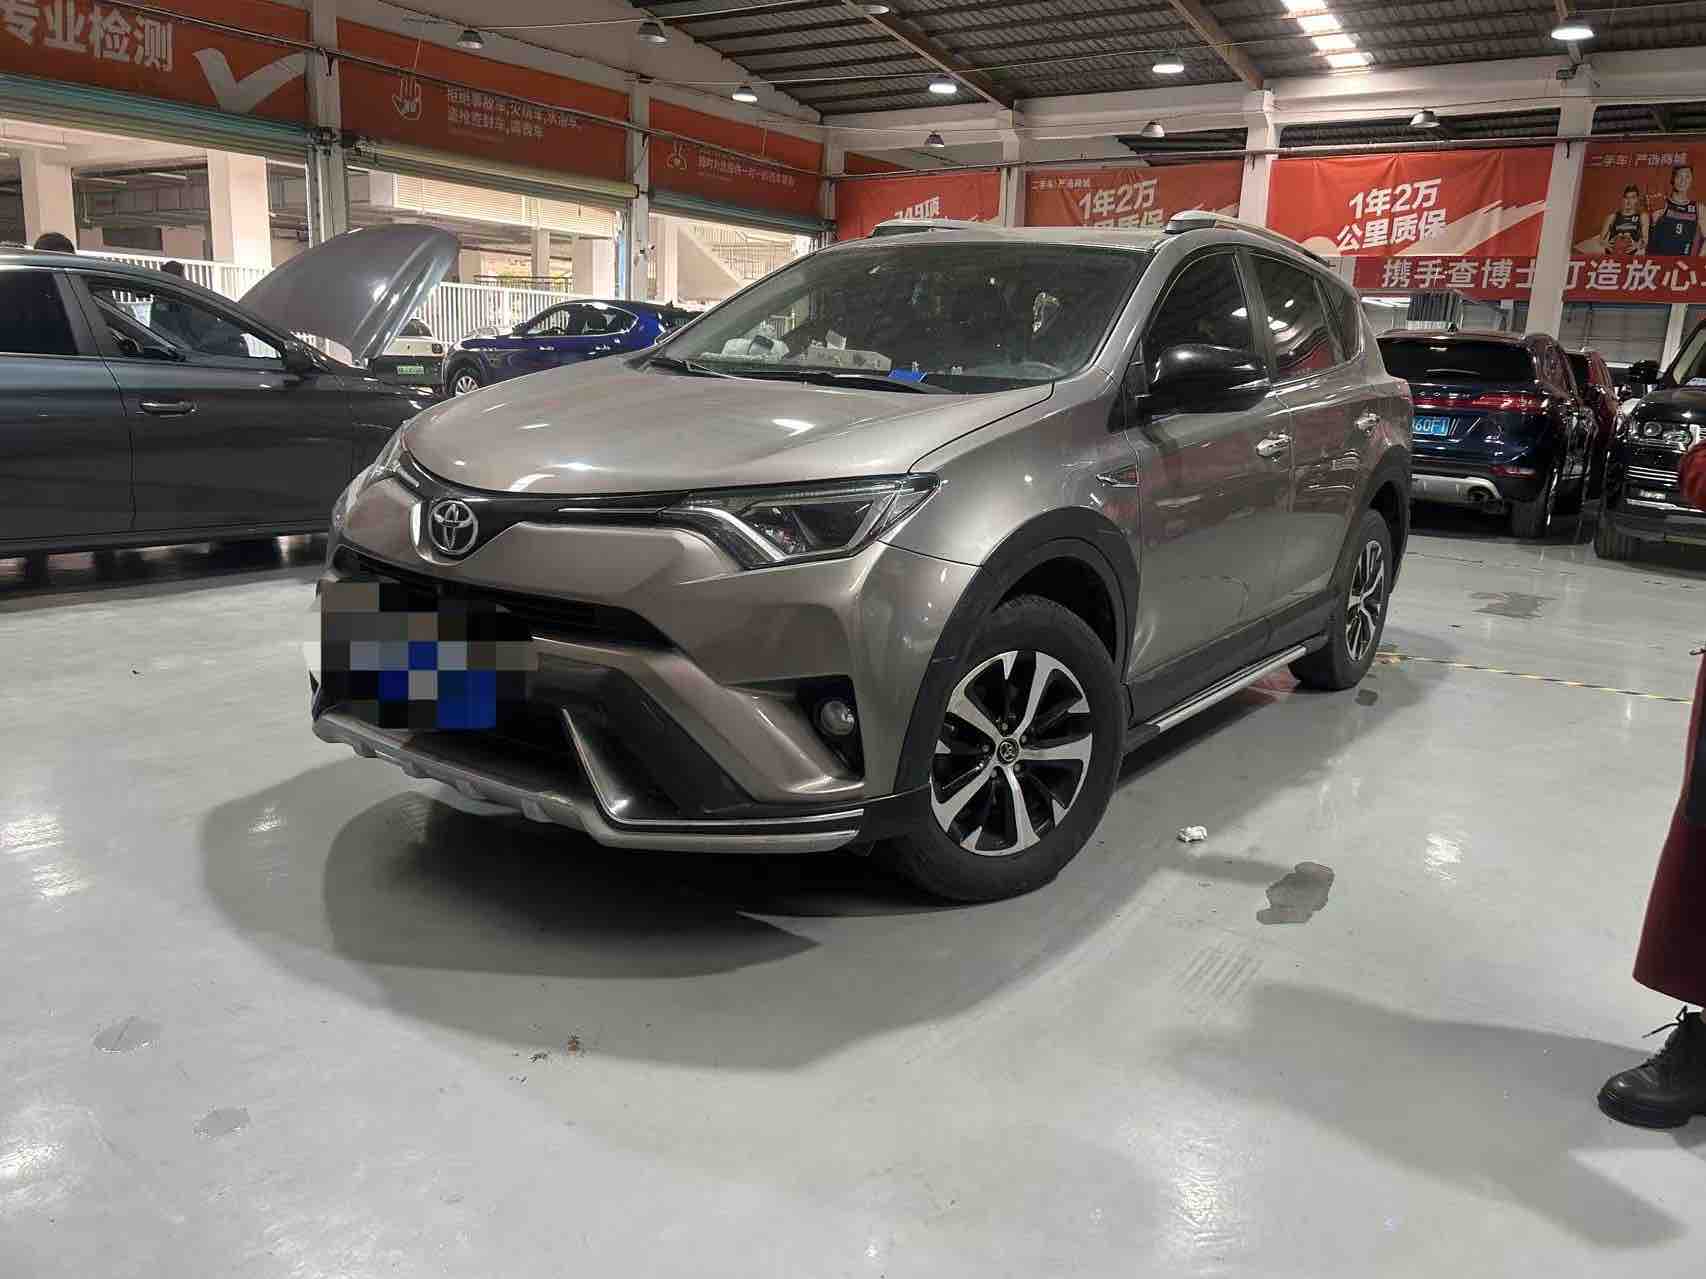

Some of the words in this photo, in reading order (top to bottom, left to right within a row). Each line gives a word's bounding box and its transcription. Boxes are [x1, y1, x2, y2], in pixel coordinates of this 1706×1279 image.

[1079, 178, 1157, 220] 1年2万
[1349, 177, 1442, 219] 1年2万
[1337, 208, 1447, 250] 公里质保
